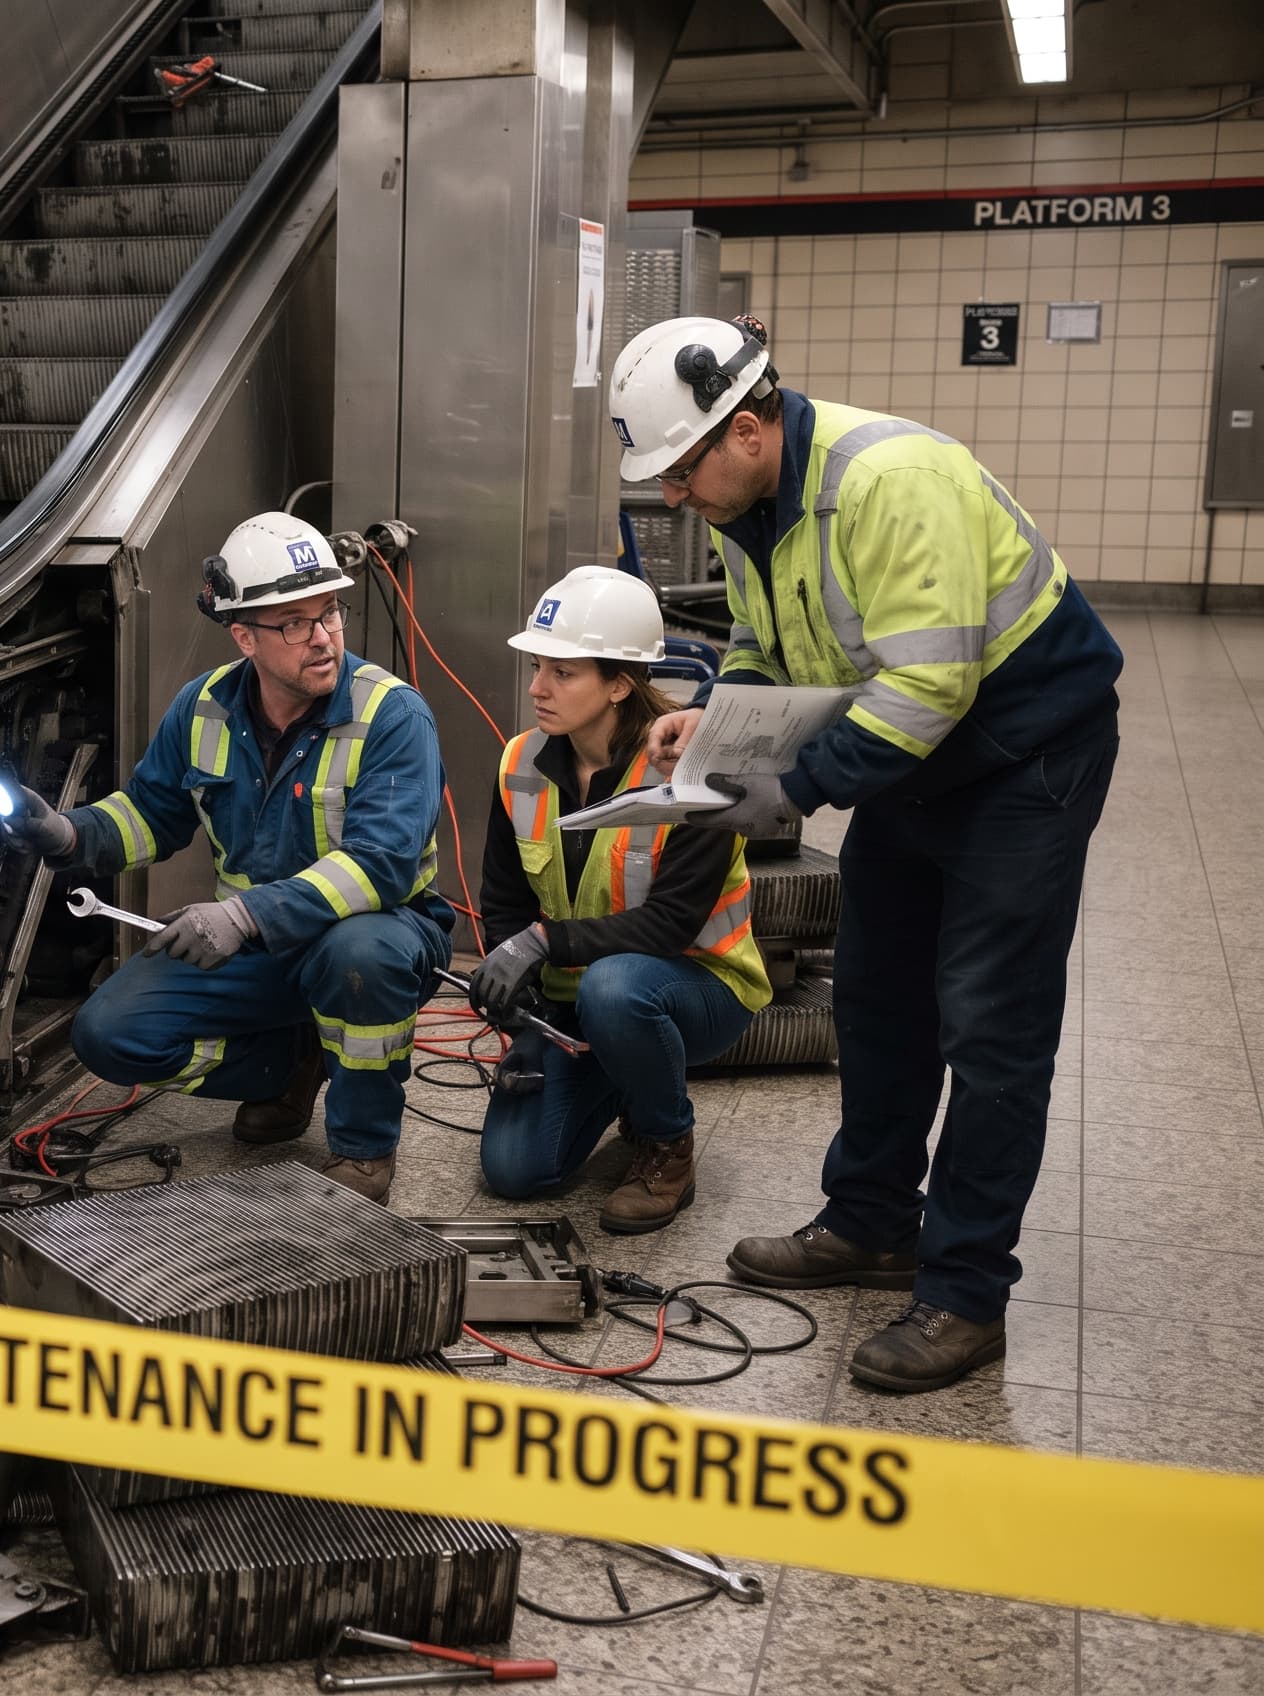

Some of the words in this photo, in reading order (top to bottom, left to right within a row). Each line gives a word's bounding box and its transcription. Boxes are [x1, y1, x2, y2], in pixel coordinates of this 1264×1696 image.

[974, 196, 1143, 226] PLATFORM
[1151, 195, 1171, 220] 3
[980, 325, 1000, 351] 3
[293, 545, 315, 565] M
[540, 603, 554, 621] A
[353, 1384, 427, 1464] IN
[460, 1398, 910, 1528] PROGRESS
